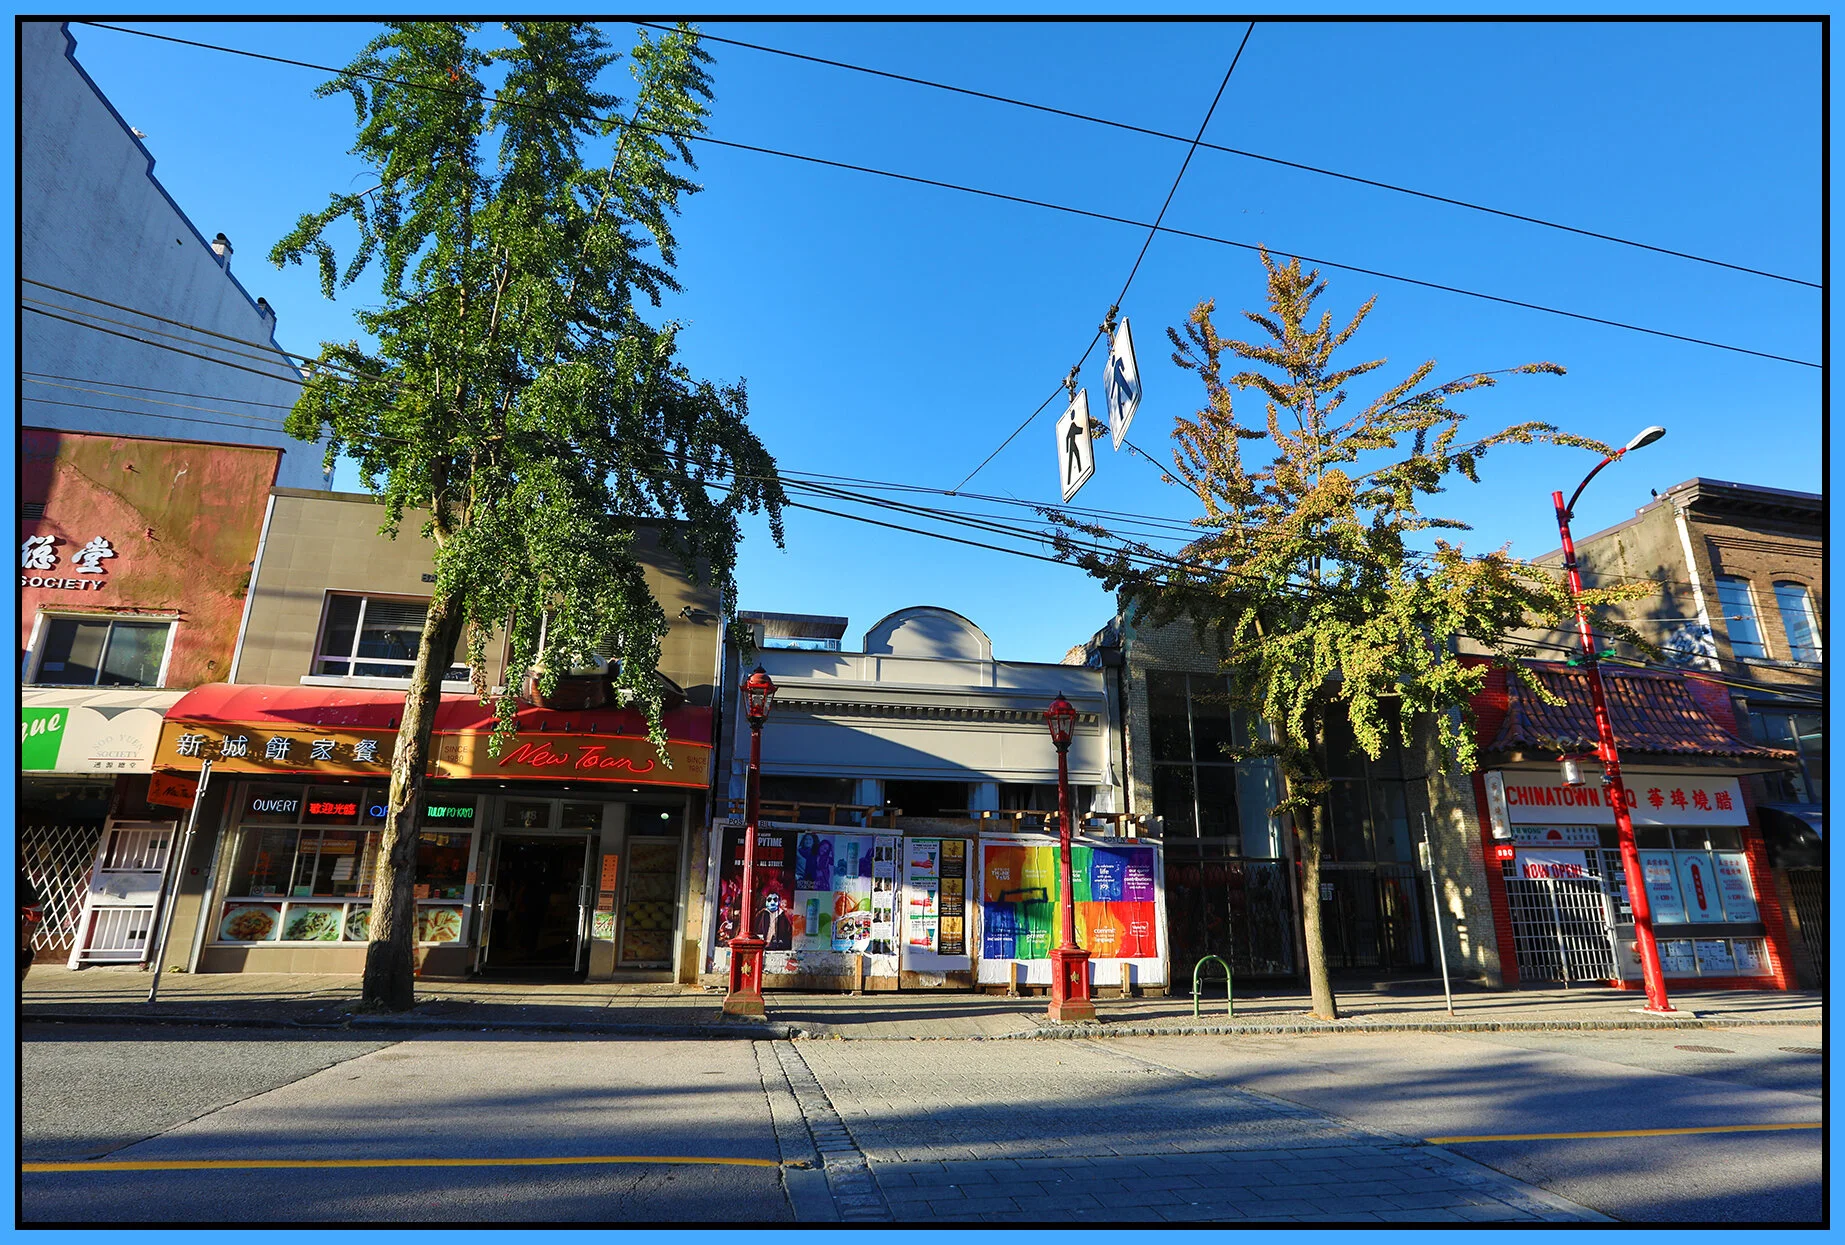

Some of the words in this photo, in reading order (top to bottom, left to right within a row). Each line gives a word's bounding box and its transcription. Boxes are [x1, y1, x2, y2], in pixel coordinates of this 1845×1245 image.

[22, 575, 103, 590] SOCIETY
[444, 745, 468, 753] SINCE
[499, 742, 568, 767] New
[447, 754, 464, 762] 1980
[687, 755, 706, 765] SINCE
[1506, 786, 1600, 807] CHINATOWN
[1602, 785, 1638, 809] BQ
[252, 799, 298, 813] OUVERT
[427, 806, 447, 817] TULOY
[447, 807, 456, 818] PO
[757, 836, 782, 847] PYTIME
[1522, 864, 1550, 879] NOW
[1551, 864, 1583, 879] OPEN!
